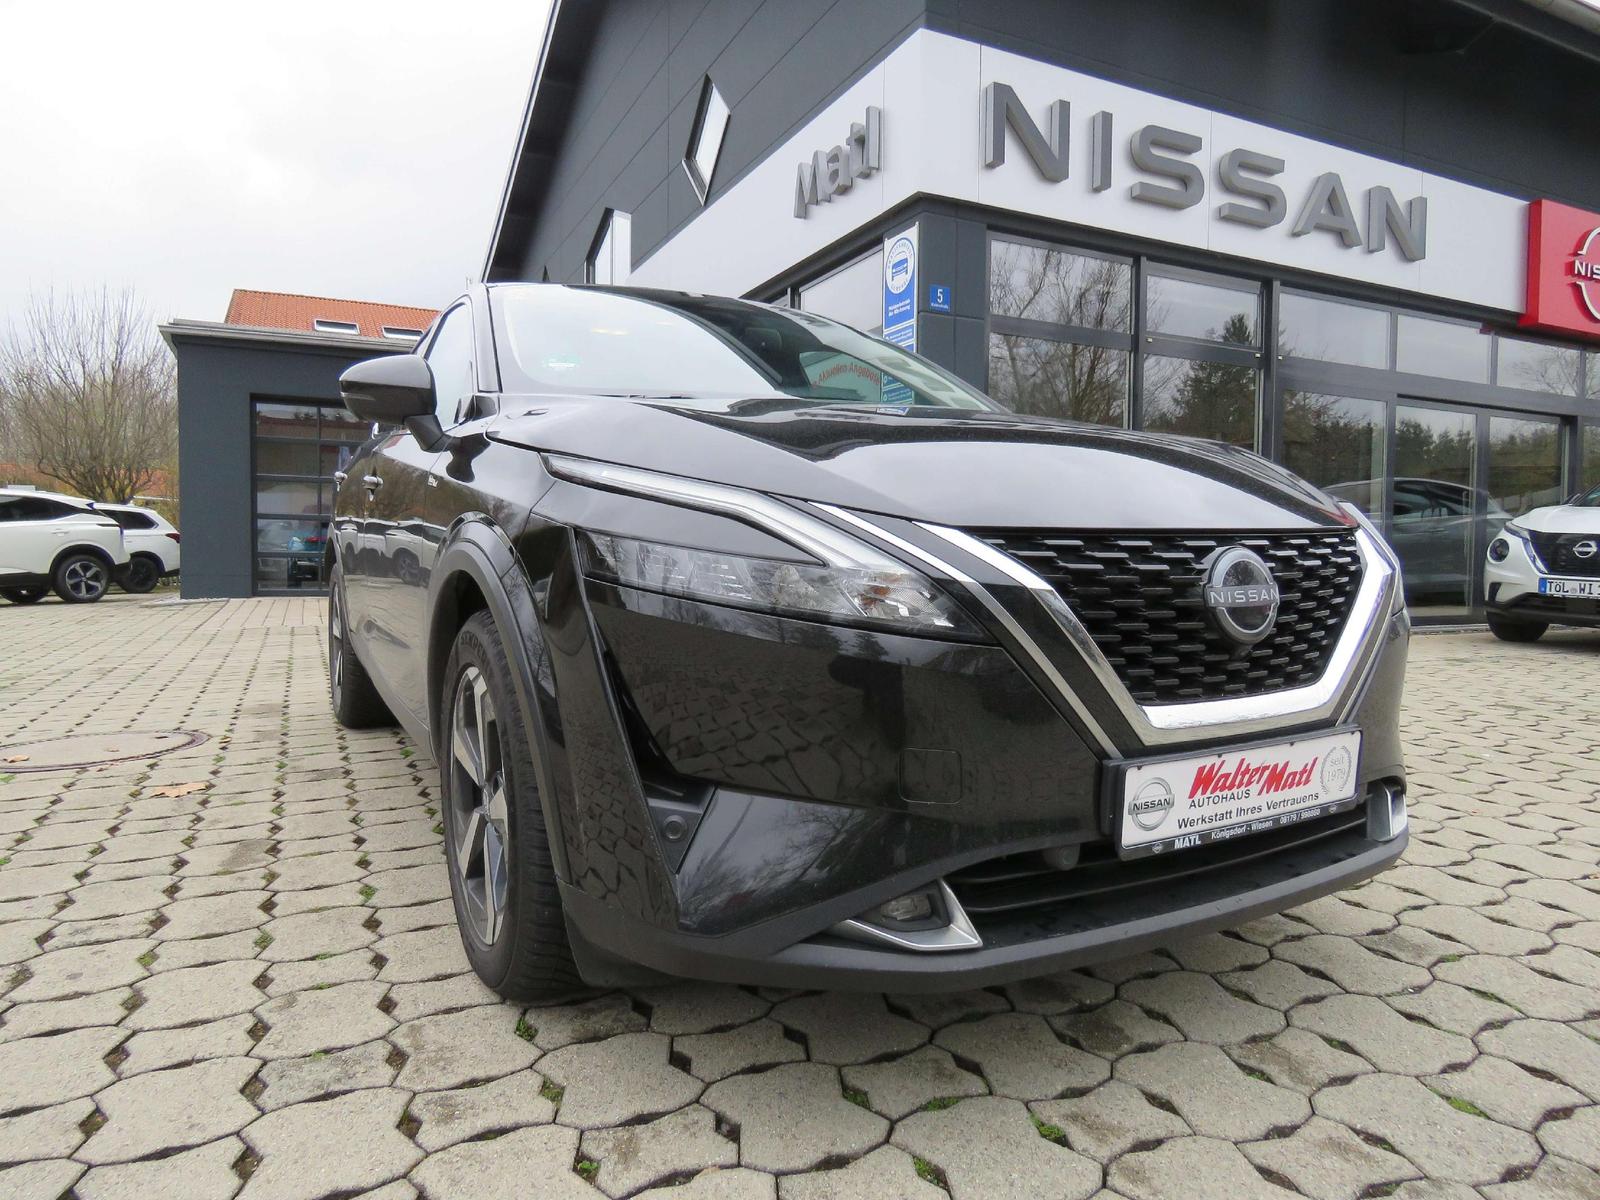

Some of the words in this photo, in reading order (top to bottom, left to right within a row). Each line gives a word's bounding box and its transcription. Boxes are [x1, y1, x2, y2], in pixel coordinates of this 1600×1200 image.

[793, 106, 880, 219] Matl
[985, 81, 1428, 263] NISSAN
[936, 288, 944, 303] 5
[1210, 588, 1279, 604] NISSAN
[1547, 580, 1569, 593] TÖL
[1579, 583, 1593, 595] WI
[1188, 757, 1271, 799] Walter
[1257, 757, 1318, 796] Matl
[1133, 797, 1171, 812] NISSAN
[1189, 789, 1251, 809] AUTOHAUS
[1177, 809, 1233, 829] Werkstatt
[1235, 805, 1262, 818] Ihres
[1266, 792, 1319, 810] Vertrauens
[1174, 833, 1202, 849] MATL
[1211, 824, 1247, 840] Königsdorf
